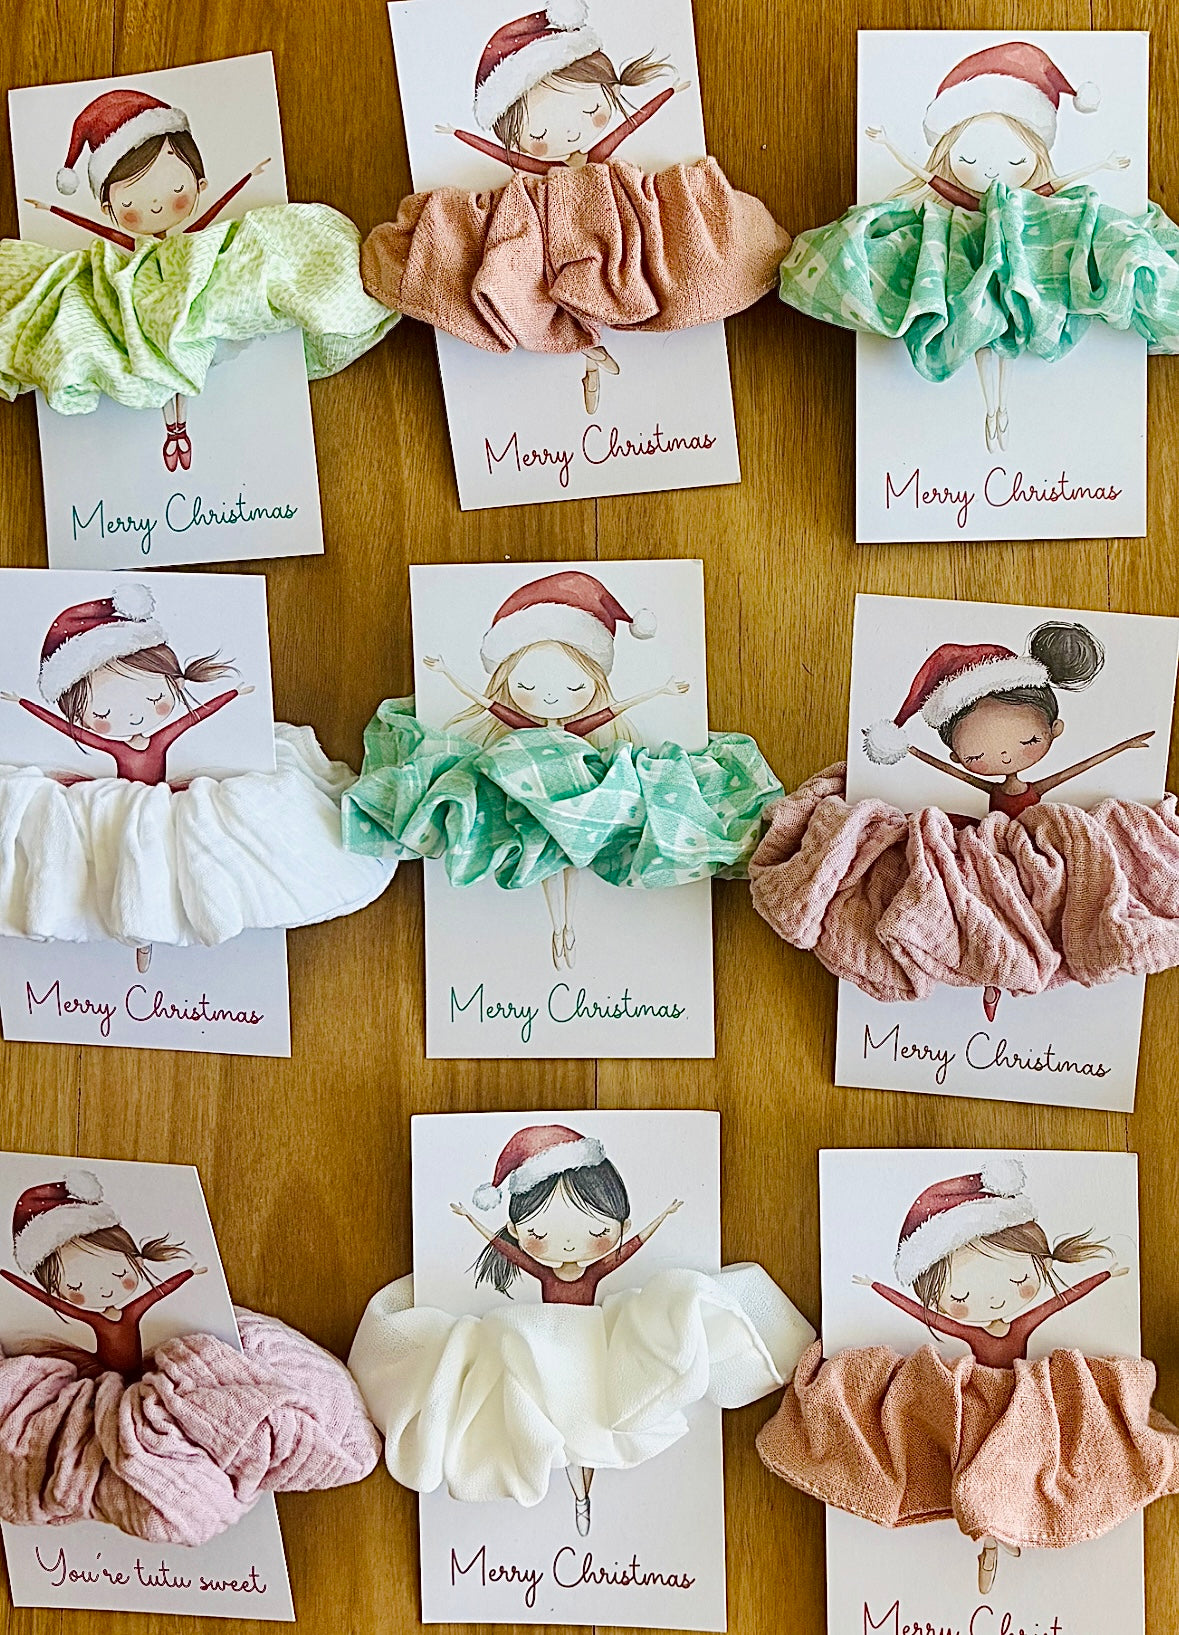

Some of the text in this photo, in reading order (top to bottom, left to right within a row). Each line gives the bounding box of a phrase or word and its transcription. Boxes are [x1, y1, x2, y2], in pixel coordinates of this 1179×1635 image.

[484, 422, 717, 489] Merry Christmas
[71, 492, 299, 555] Merry Christmas
[886, 466, 1123, 529] Merry Christmas
[26, 979, 265, 1038] Merry Christmas
[450, 982, 686, 1044] Merry Christmas
[863, 1023, 1112, 1086] Merry Christmas
[35, 1546, 267, 1594] You're tutu sweet
[451, 1544, 696, 1609] Merry Christmas
